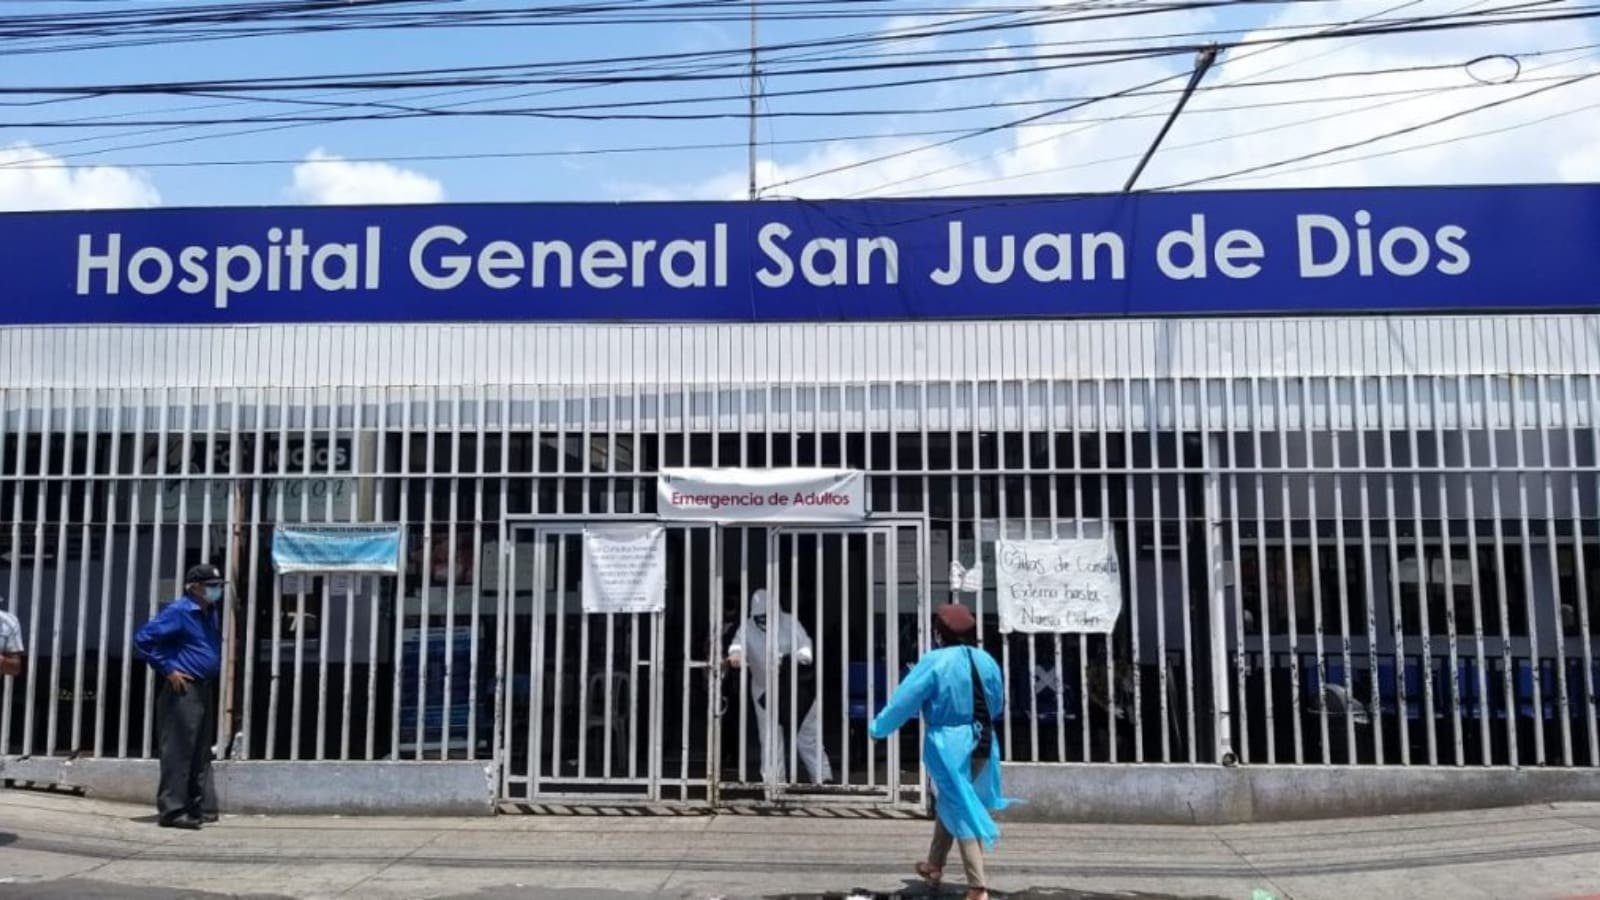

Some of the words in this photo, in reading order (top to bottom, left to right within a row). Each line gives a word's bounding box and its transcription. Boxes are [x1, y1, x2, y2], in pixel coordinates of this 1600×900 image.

[76, 226, 381, 308] Hospital
[409, 224, 729, 290] General
[756, 222, 898, 287] San
[930, 221, 1126, 285] Juan
[1156, 213, 1266, 280] de
[1297, 209, 1471, 278] Dios
[671, 491, 765, 509] Emergencia
[767, 491, 789, 506] de
[793, 491, 850, 506] Adultos
[1054, 554, 1070, 572] de
